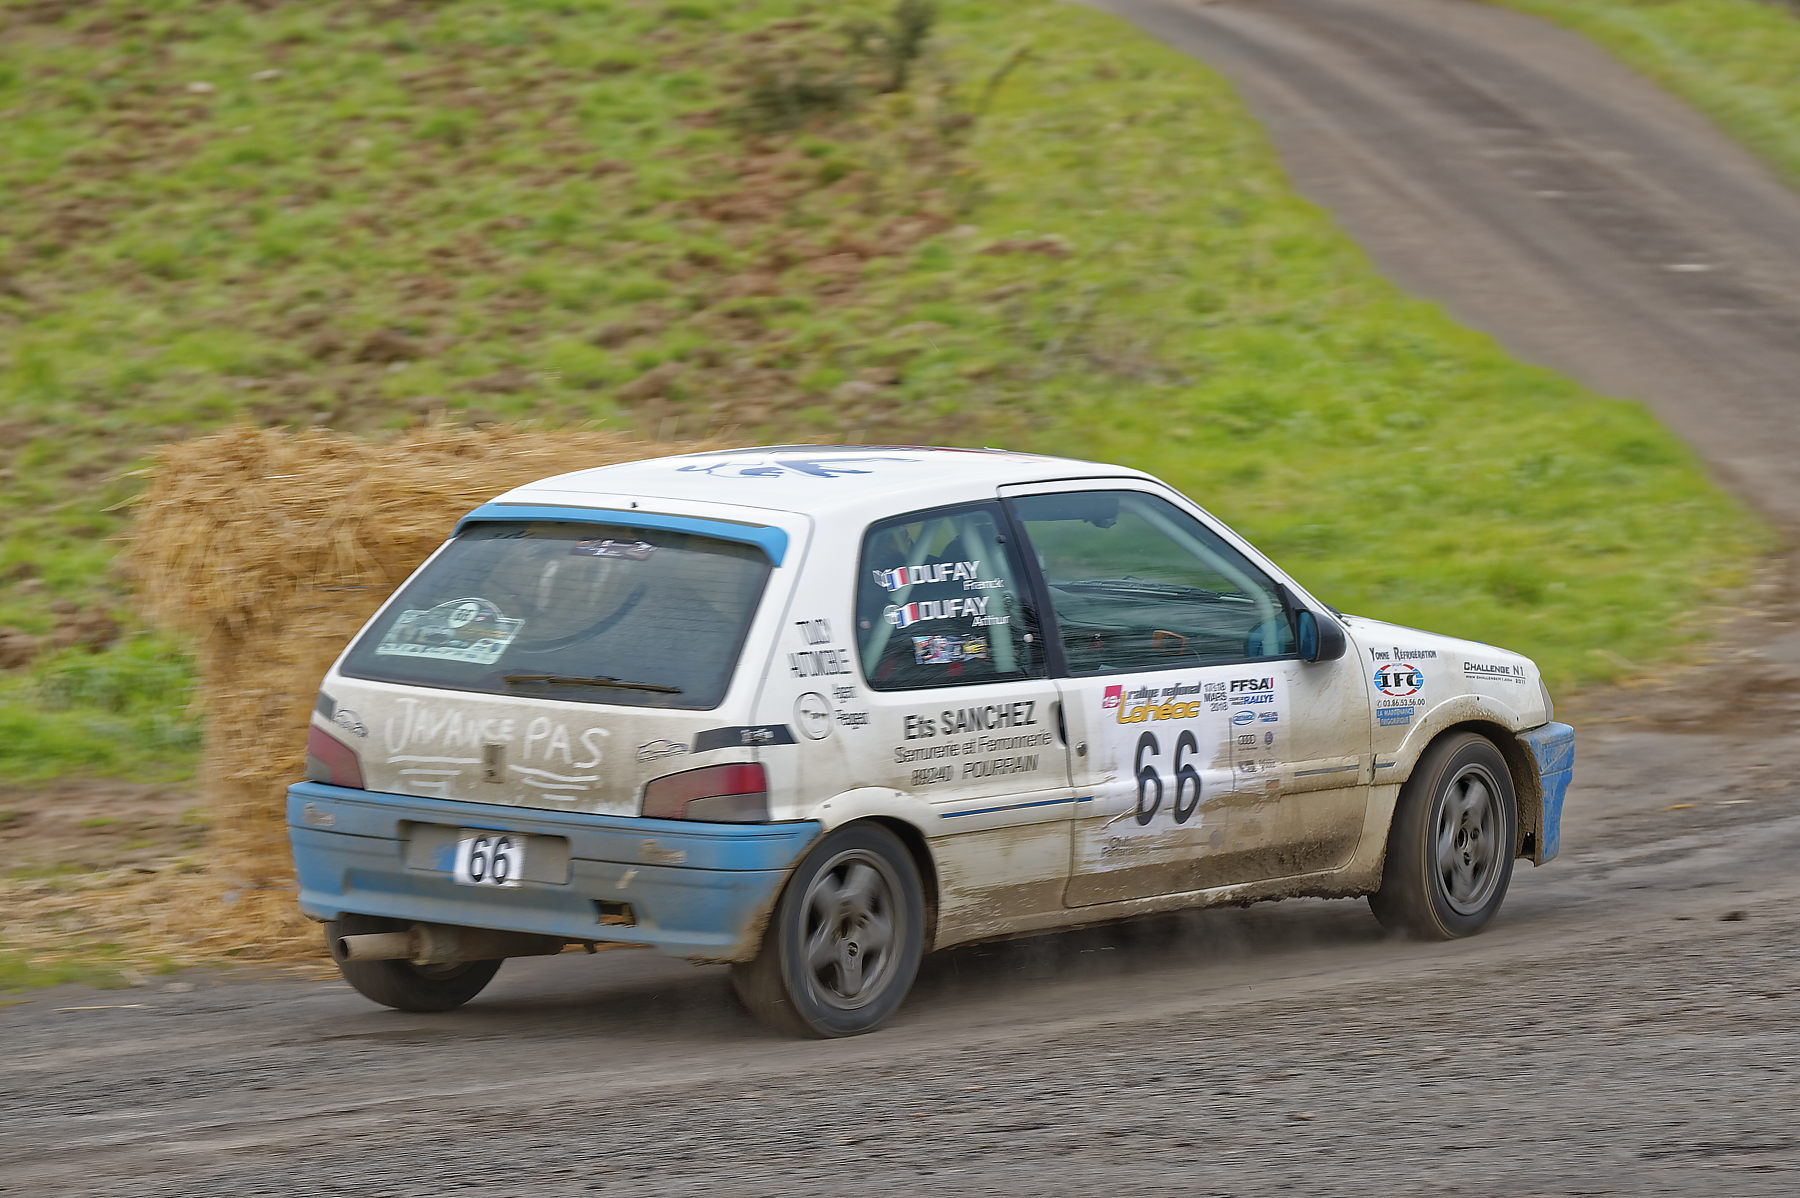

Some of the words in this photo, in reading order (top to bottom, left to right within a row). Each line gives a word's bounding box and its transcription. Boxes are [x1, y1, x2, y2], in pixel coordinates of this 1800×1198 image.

[908, 561, 980, 585] DUFAY
[918, 596, 989, 621] DUFAY
[1378, 672, 1420, 687] IFC
[1513, 665, 1524, 676] N1
[1204, 692, 1227, 702] MARS
[1230, 678, 1269, 692] FFSA
[1117, 691, 1201, 724] Lohéac
[1244, 694, 1274, 705] RALLYE
[904, 714, 936, 740] Ets
[940, 700, 1038, 735] SANCHEZ
[523, 717, 610, 768] PAS
[1134, 730, 1201, 826] 66
[470, 835, 512, 884] 66
